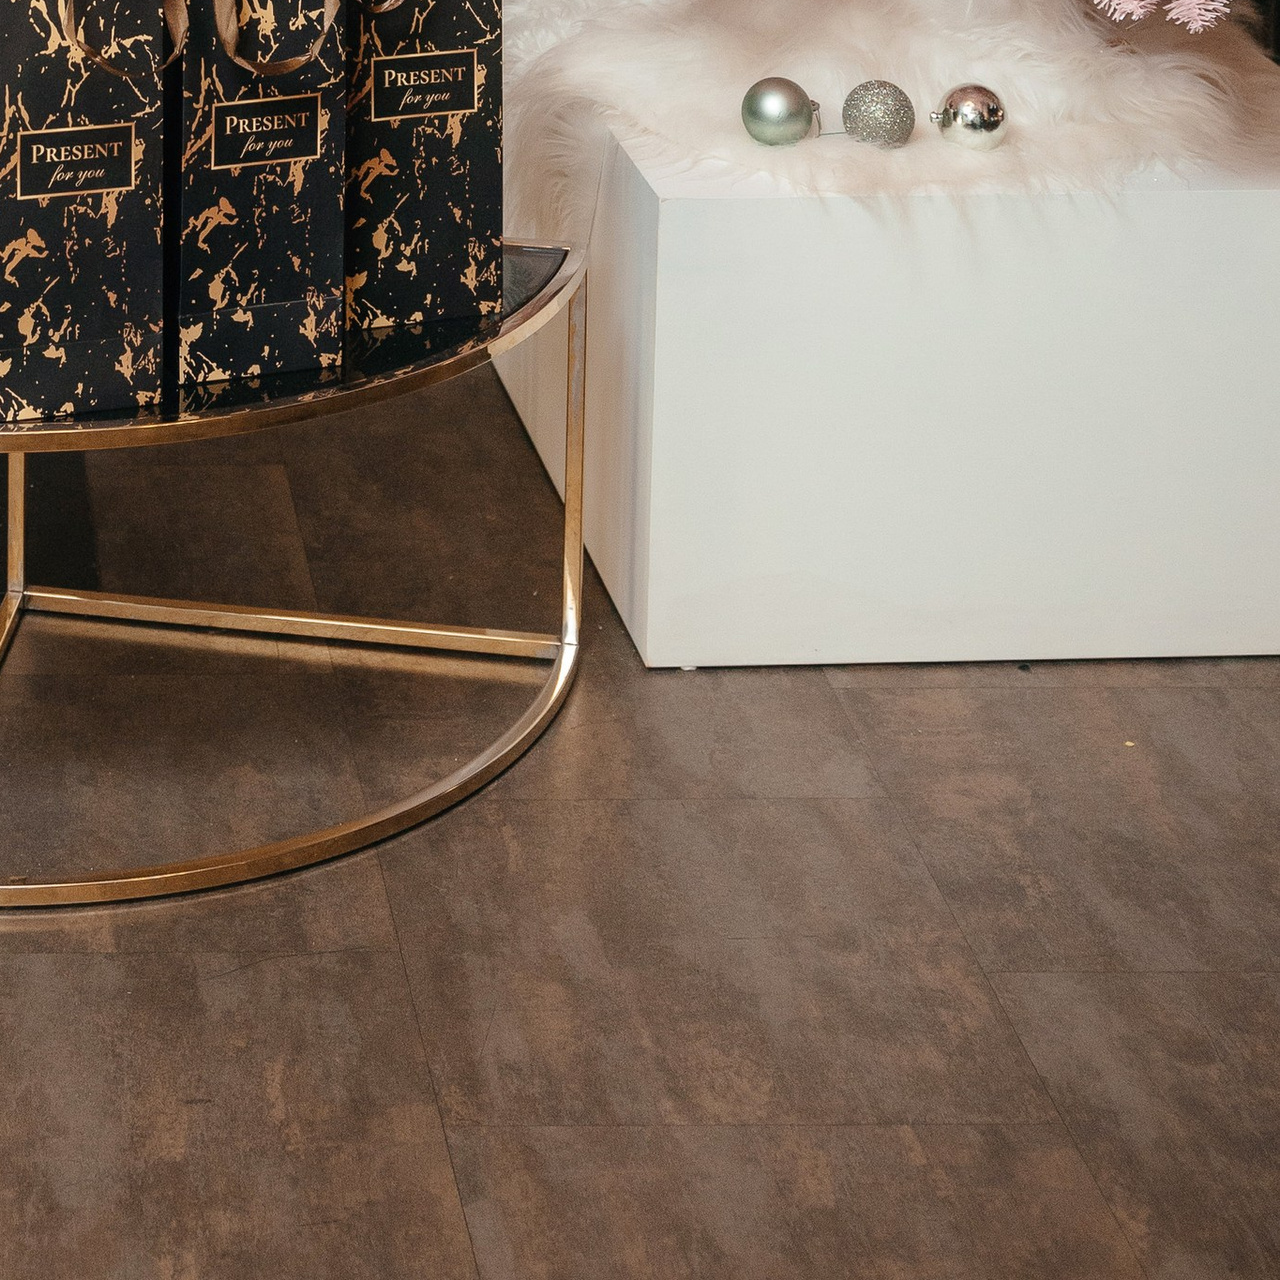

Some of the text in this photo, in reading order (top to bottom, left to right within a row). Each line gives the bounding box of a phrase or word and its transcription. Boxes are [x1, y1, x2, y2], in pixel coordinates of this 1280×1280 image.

[383, 66, 466, 88] PRESENT
[398, 87, 451, 111] for you
[224, 111, 310, 135] PRESENT
[31, 141, 123, 164] PRESENT
[240, 134, 294, 159] for you
[47, 163, 106, 188] for you
